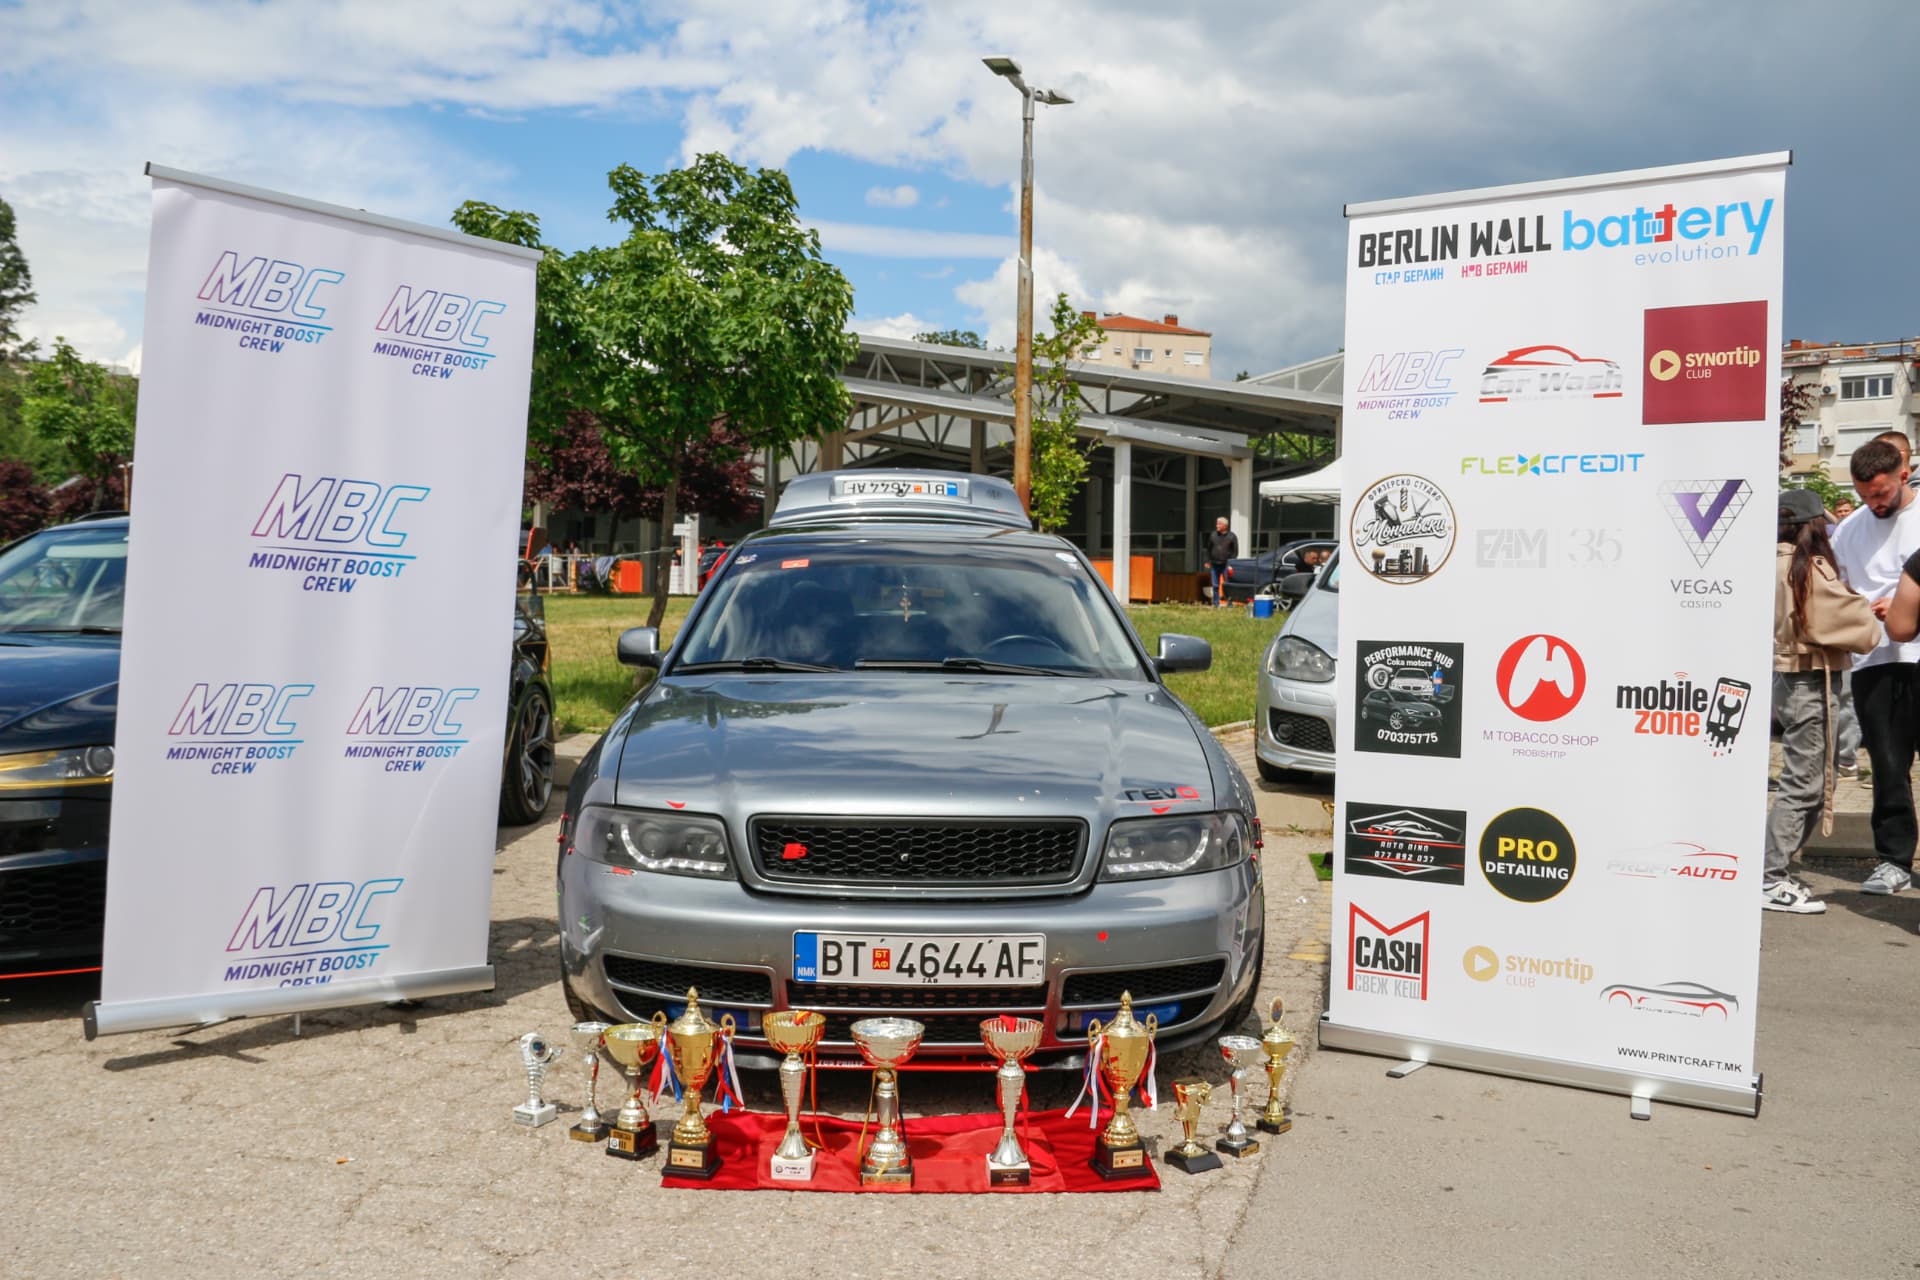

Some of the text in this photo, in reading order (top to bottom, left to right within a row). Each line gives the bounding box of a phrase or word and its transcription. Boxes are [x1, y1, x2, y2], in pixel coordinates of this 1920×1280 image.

[1563, 198, 1774, 256] battery
[1358, 215, 1552, 268] BERLIN WALL
[1635, 242, 1740, 267] evolution
[197, 251, 345, 320] MBC
[195, 312, 326, 344] MIDNIGHT BOOST
[375, 285, 506, 348] MBC
[239, 336, 285, 353] CREW
[373, 342, 489, 371] MIDNIGHT BOOST
[412, 364, 454, 379] CREW
[1357, 348, 1465, 393] MBC
[1686, 369, 1712, 379] CLUB
[1356, 397, 1451, 410] MIDNIGHT BOOST
[1388, 409, 1421, 420] CREW
[250, 473, 431, 547] MBC
[249, 552, 407, 578] MIDNIGHT BOOST
[303, 576, 357, 593] CREW
[1670, 578, 1733, 595] VEGAS
[1680, 598, 1722, 609] casino
[1364, 645, 1454, 669] PERFORMANCE HUB
[1406, 659, 1433, 667] motors
[1616, 680, 1708, 713] mobile
[168, 683, 316, 735] MBC
[346, 686, 480, 735] MBC
[1634, 709, 1700, 737] zone
[1377, 728, 1439, 744] 070375775
[1482, 731, 1600, 747] M TOBACCO SHOP
[166, 746, 296, 760] MIDNIGHT BOOST
[345, 745, 462, 758] MIDNIGHT BOOST
[1512, 748, 1567, 760] PROBISHTIP
[211, 761, 257, 775] CREW
[384, 760, 426, 772] CREW
[1380, 841, 1404, 849] AUTO
[1497, 836, 1558, 862] PRO
[1485, 861, 1569, 881] DETAILING
[225, 878, 404, 952] MBC
[797, 940, 1039, 979] NMK BT 4644 AF
[873, 960, 889, 969] АФ
[874, 950, 888, 959] БТ
[1355, 936, 1422, 974] CASH
[224, 952, 380, 982] MIDNIGHT BOOST
[1354, 974, 1421, 1000] СВЕЖ КЕШ
[1506, 976, 1535, 988] CLUB
[1617, 1047, 1743, 1073] WWW.PRINTCRAFT.MK
